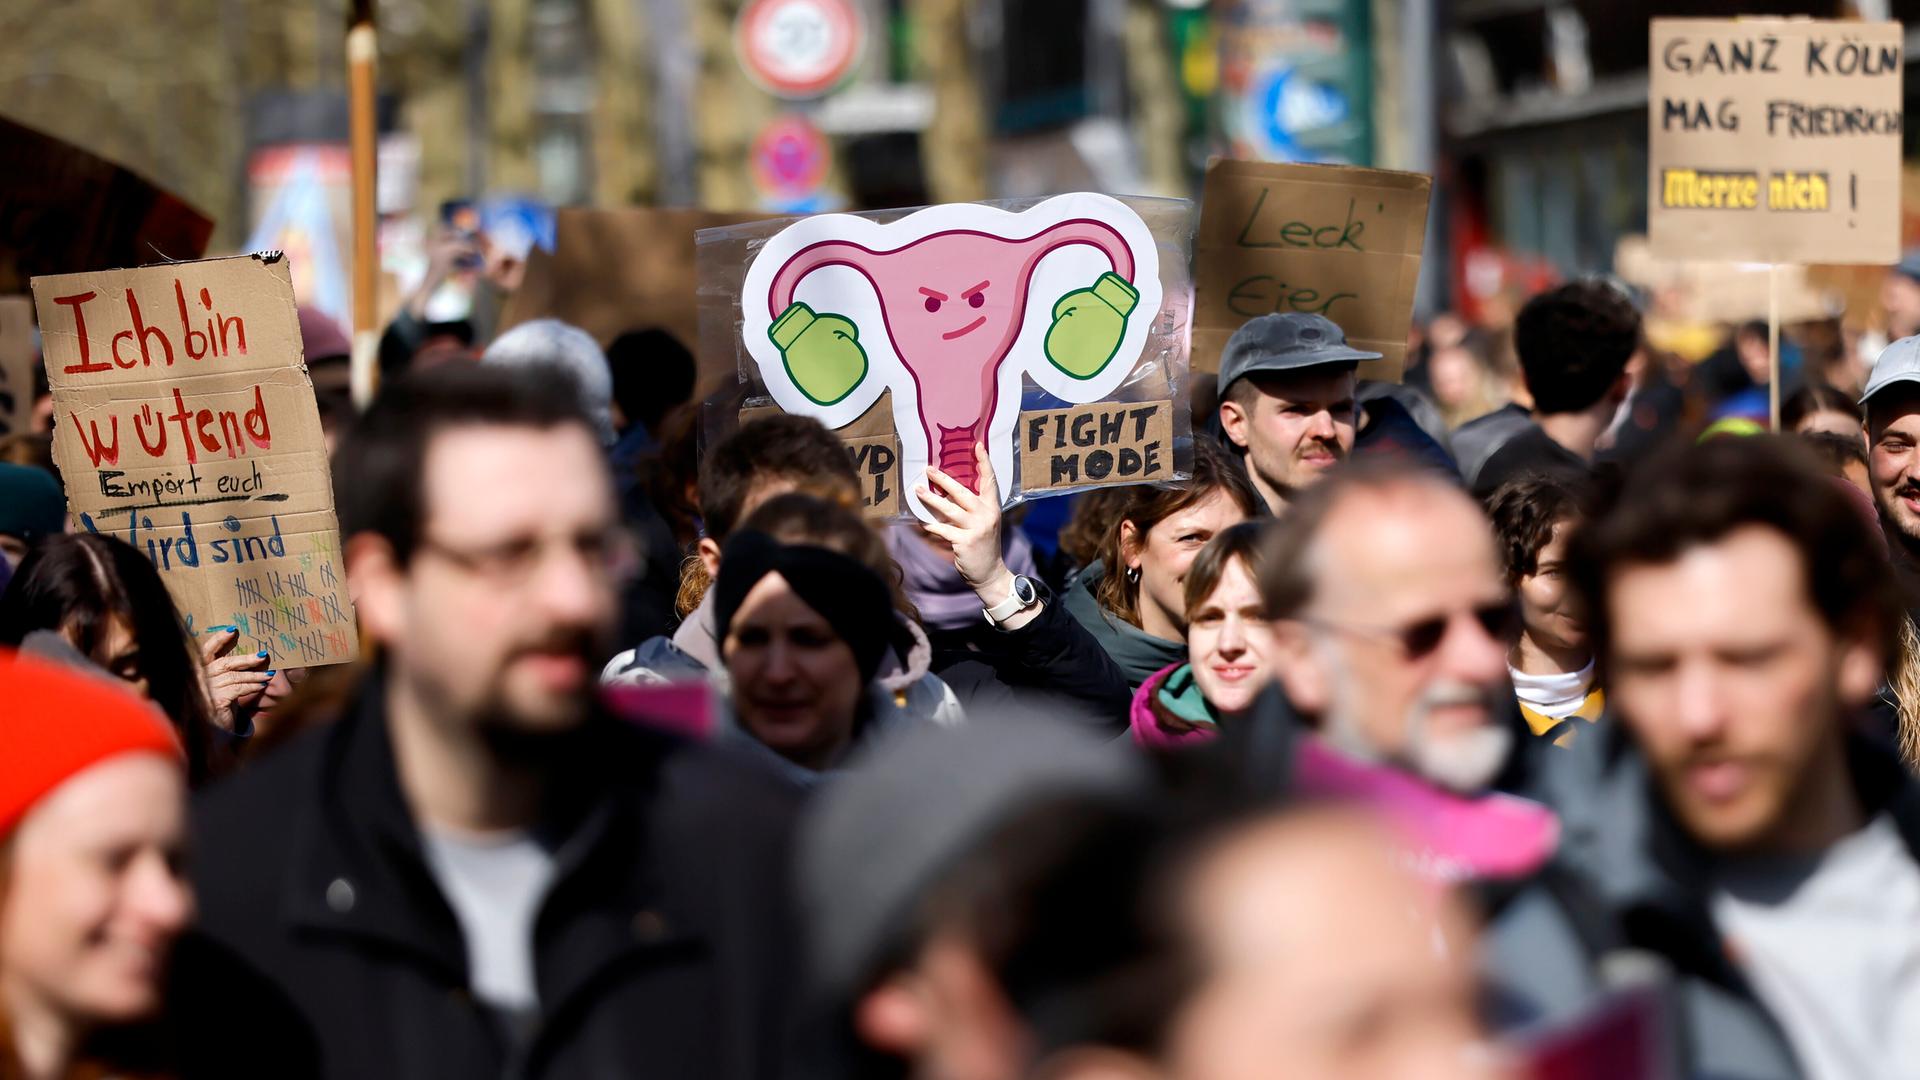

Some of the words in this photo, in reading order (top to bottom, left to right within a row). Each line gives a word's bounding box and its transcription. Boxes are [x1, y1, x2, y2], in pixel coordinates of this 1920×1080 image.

[1663, 35, 1780, 75] GANZ
[1806, 36, 1899, 76] KÖLN
[1663, 99, 1739, 131] MAG
[1768, 171, 1828, 209] nich
[1227, 275, 1359, 317] Eier
[53, 290, 174, 374] Ich
[175, 278, 248, 360] bin
[1028, 405, 1159, 452] FIGHT
[98, 463, 202, 506] Empört
[217, 461, 263, 493] euch
[1050, 440, 1161, 486] MODE
[210, 514, 286, 563] sind
